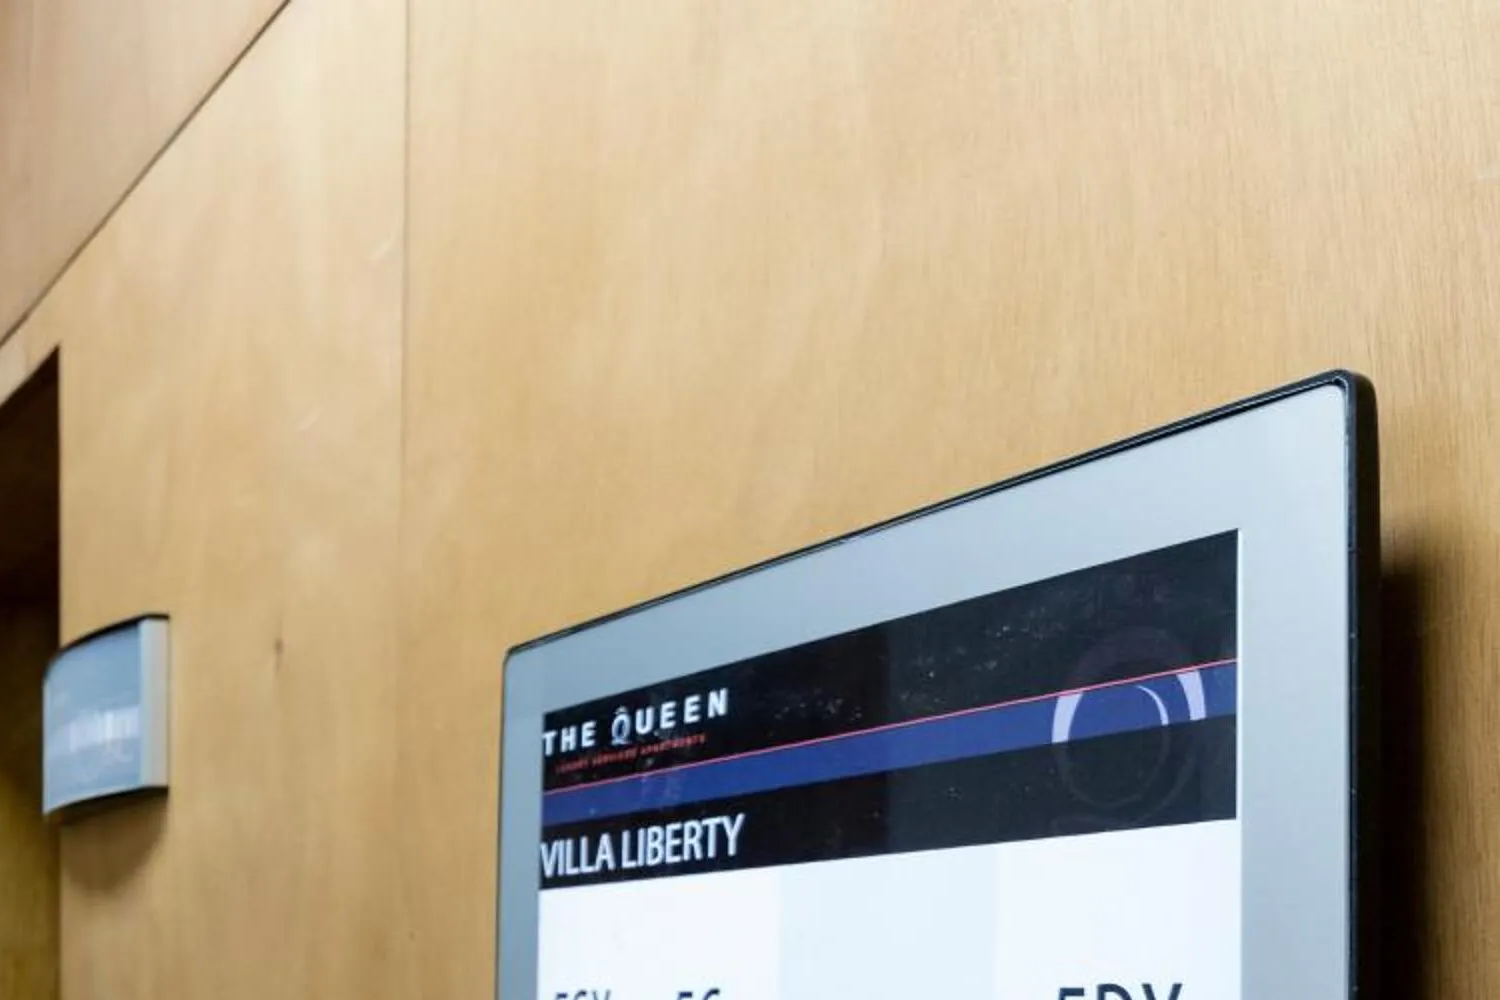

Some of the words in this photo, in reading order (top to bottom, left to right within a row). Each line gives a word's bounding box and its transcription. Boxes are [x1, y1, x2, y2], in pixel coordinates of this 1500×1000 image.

[543, 720, 597, 757] THE
[611, 688, 729, 745] QUEEN
[540, 833, 616, 878] VILLA
[621, 813, 746, 870] LIBERTY
